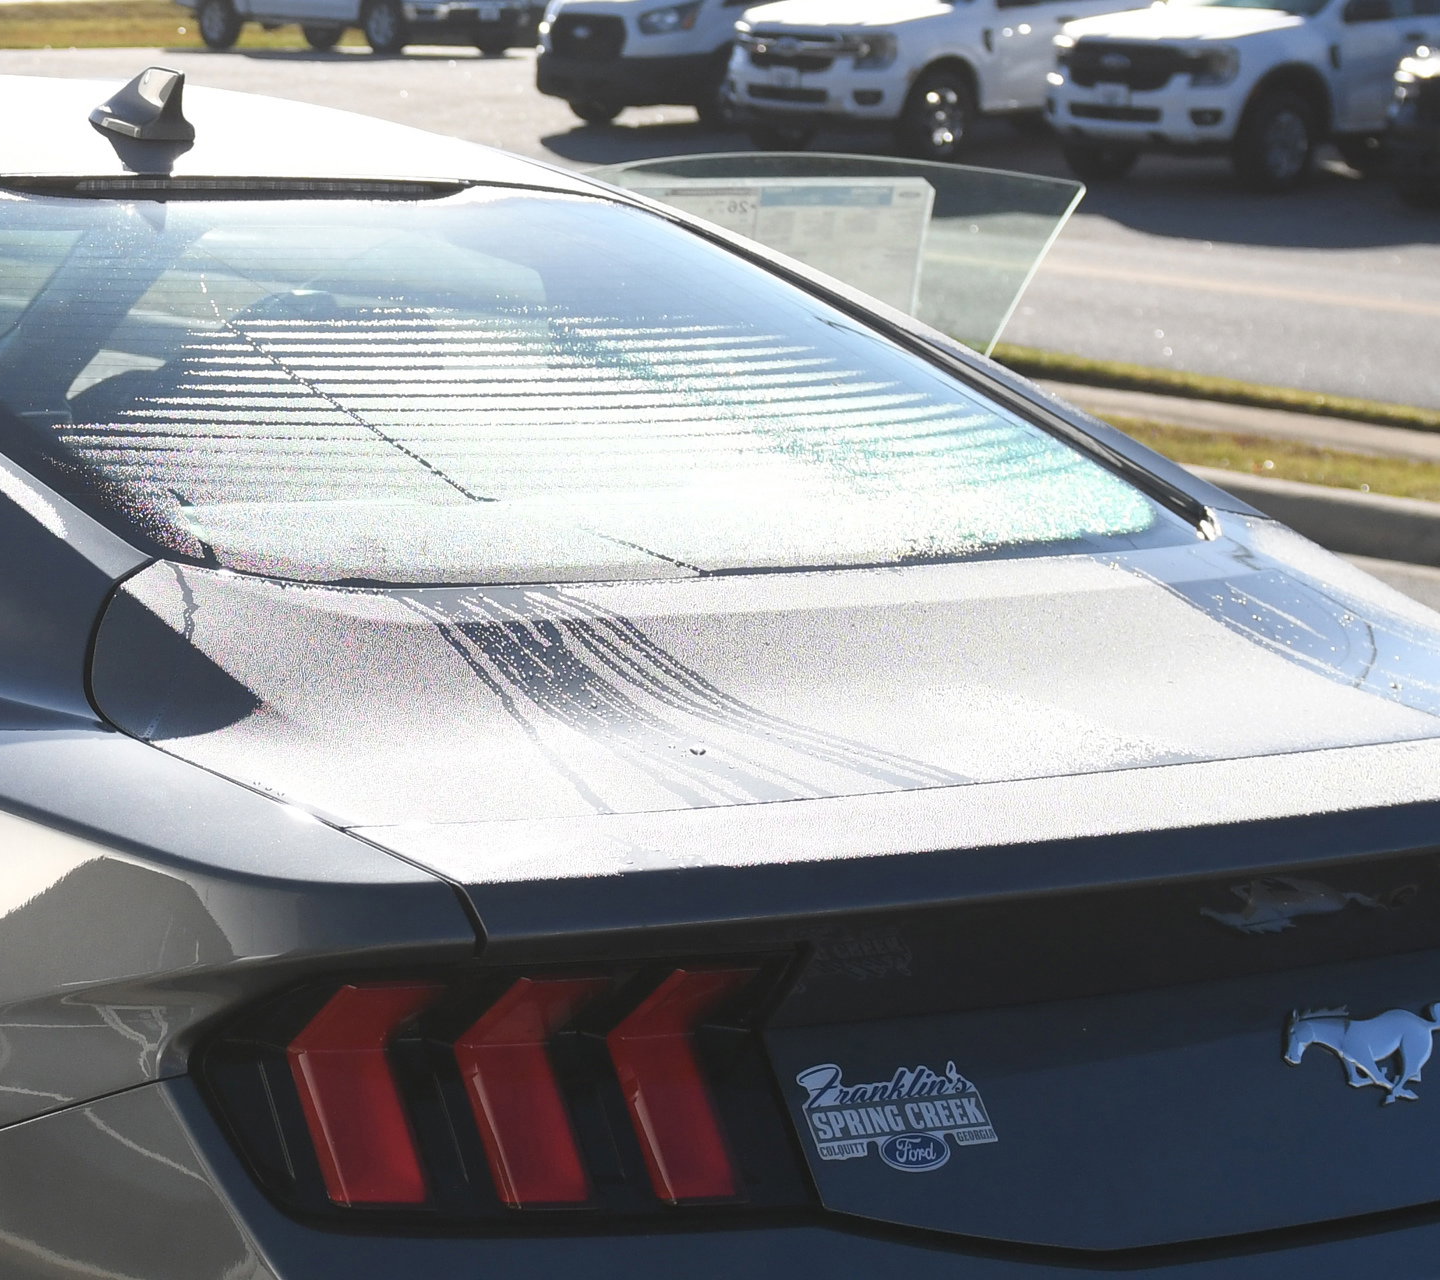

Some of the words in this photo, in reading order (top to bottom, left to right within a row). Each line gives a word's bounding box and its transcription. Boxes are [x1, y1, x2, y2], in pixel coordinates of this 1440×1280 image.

[798, 1063, 972, 1109] Franklin's
[812, 1104, 905, 1140] SPRING
[904, 1097, 986, 1130] CREEK
[956, 1128, 996, 1142] GEORGIA
[820, 1142, 866, 1157] COLQUITT
[895, 1138, 937, 1163] Ford
